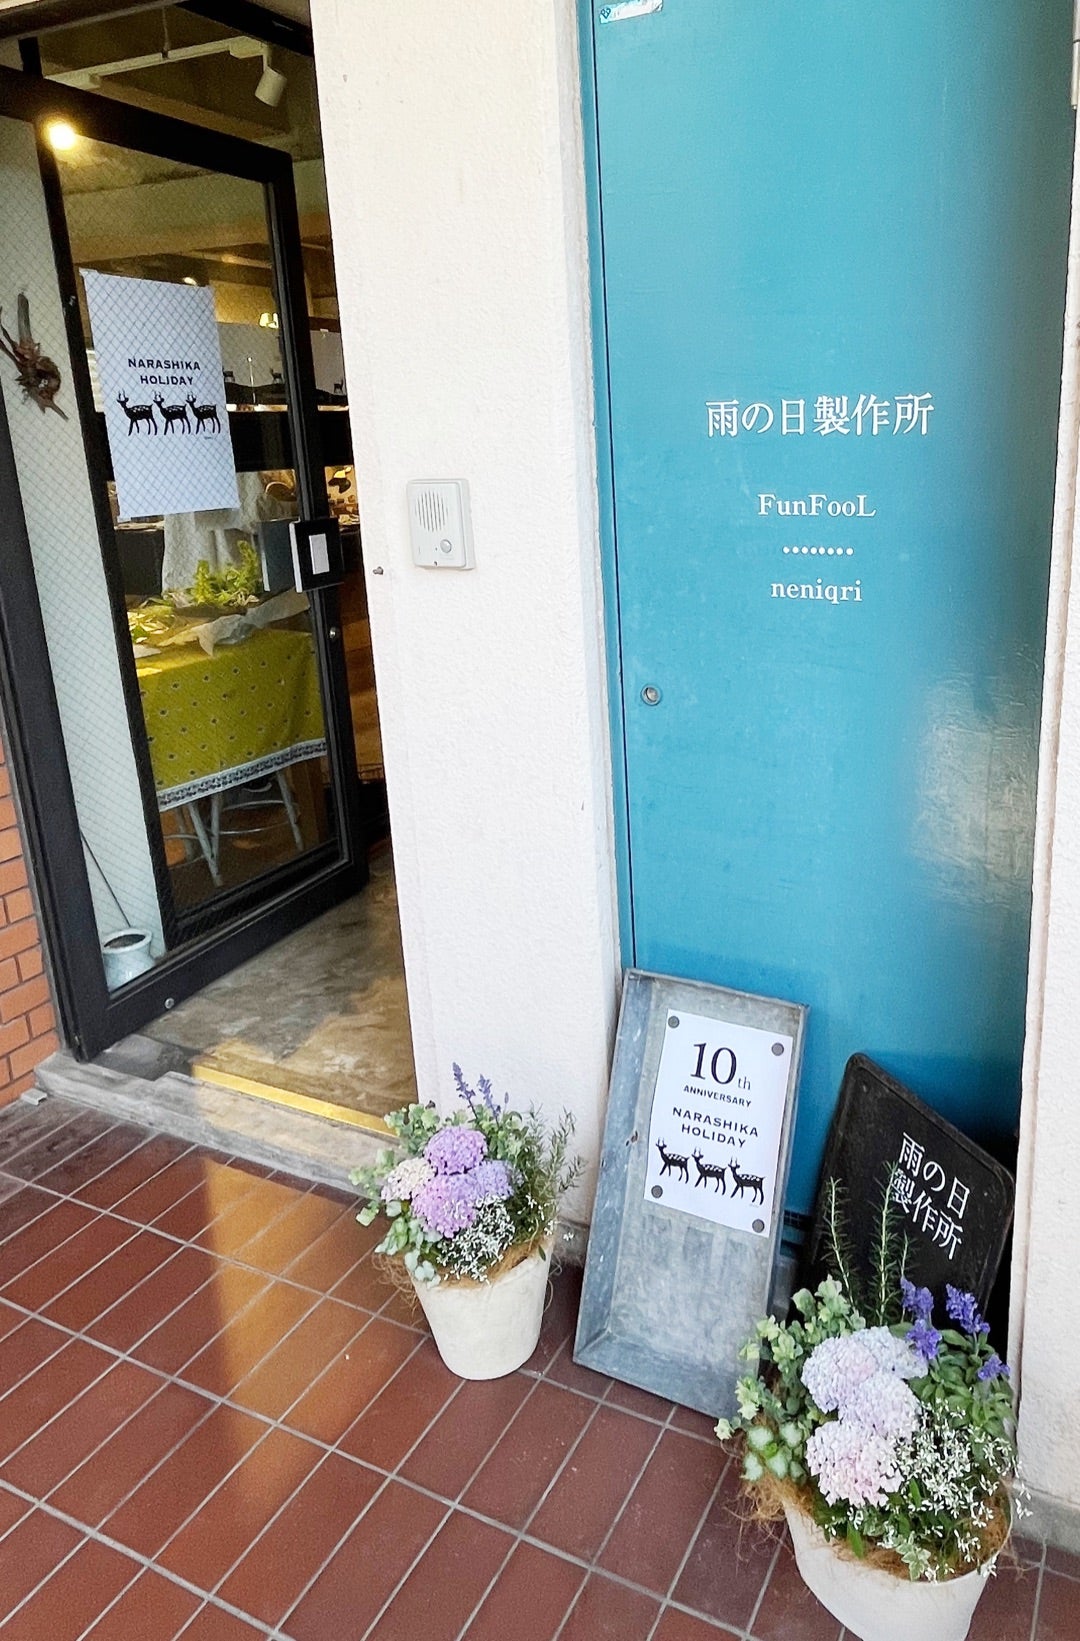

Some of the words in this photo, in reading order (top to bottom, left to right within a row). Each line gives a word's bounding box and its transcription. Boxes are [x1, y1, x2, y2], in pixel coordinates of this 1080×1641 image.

[128, 358, 200, 371] NARASHIKA
[140, 375, 194, 386] HOLIDAY
[705, 392, 934, 437] 雨の日製作所
[757, 493, 876, 517] FunFooL
[770, 578, 863, 605] neniqri
[690, 1042, 752, 1091] 10th
[683, 1084, 752, 1108] ANNIVERSARY
[672, 1106, 759, 1137] NARASHIKA
[681, 1123, 747, 1149] HOLIDAY
[899, 1131, 970, 1219] 雨の日
[890, 1167, 964, 1260] 製作所
